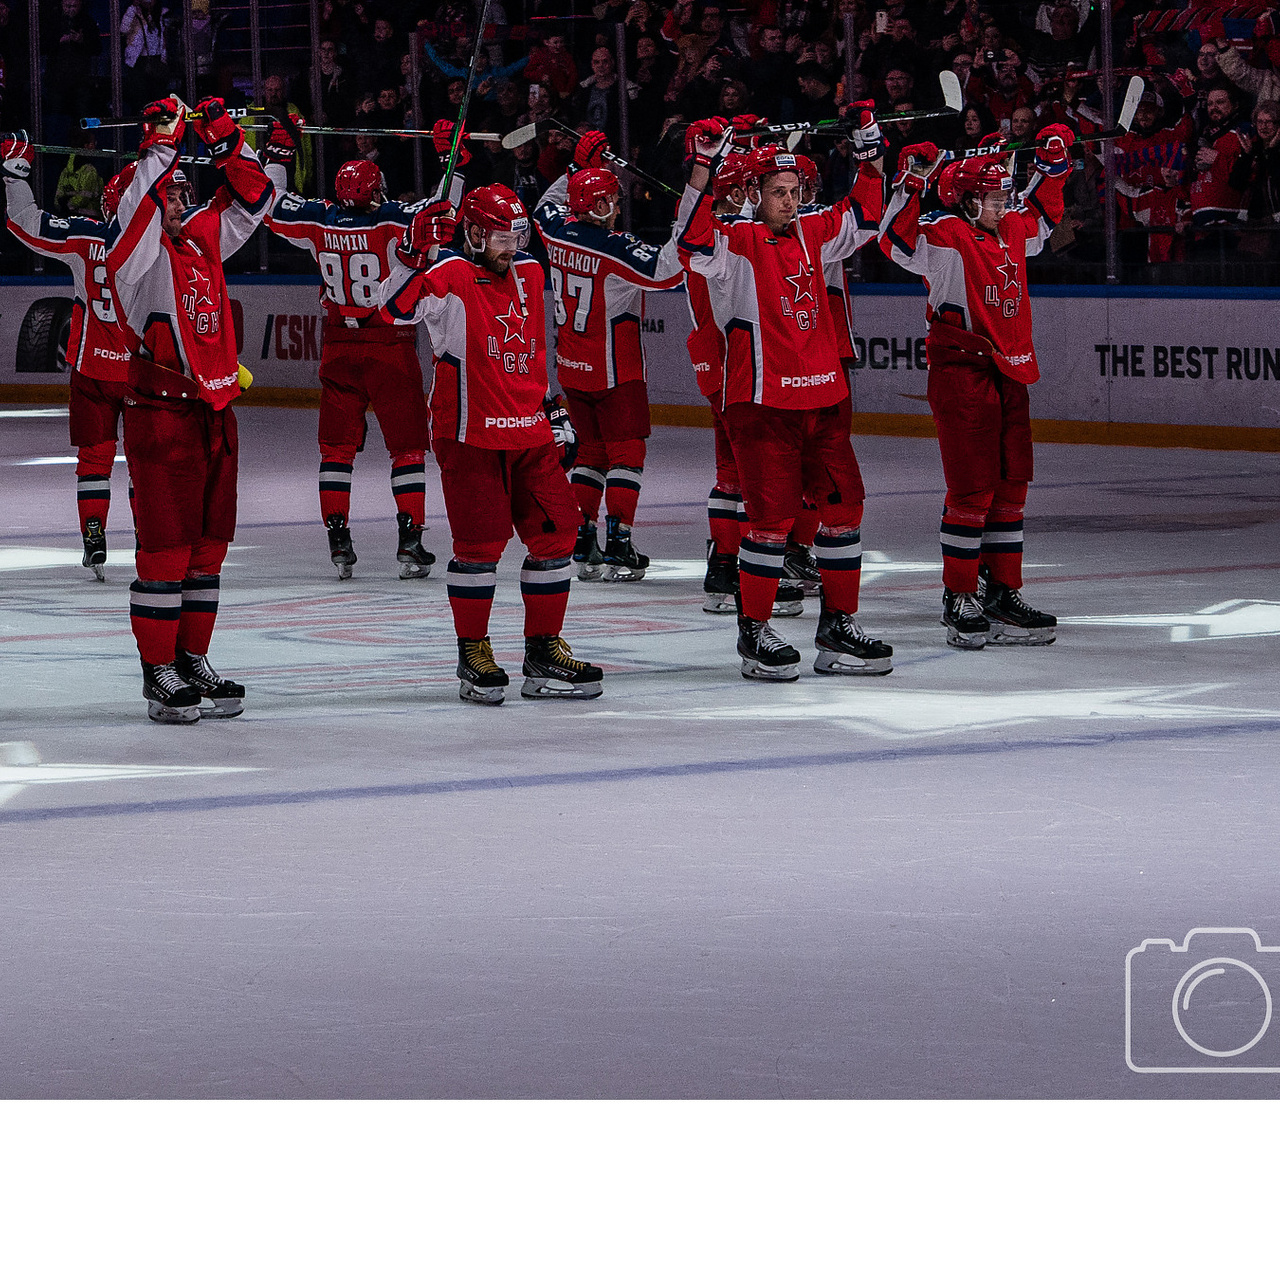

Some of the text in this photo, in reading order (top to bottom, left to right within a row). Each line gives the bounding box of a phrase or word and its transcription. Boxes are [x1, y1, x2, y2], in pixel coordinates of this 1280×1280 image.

[767, 121, 811, 132] CCM
[964, 145, 1001, 158] CCM
[509, 202, 524, 215] 89
[324, 232, 369, 251] MAMIN
[318, 251, 381, 308] 98
[182, 293, 221, 334] ЦСК
[550, 265, 594, 333] 87
[781, 294, 819, 331] ЦС
[985, 283, 1022, 318] ЦС
[261, 313, 327, 361] /CSK
[1094, 344, 1280, 381] THE BEST RUN
